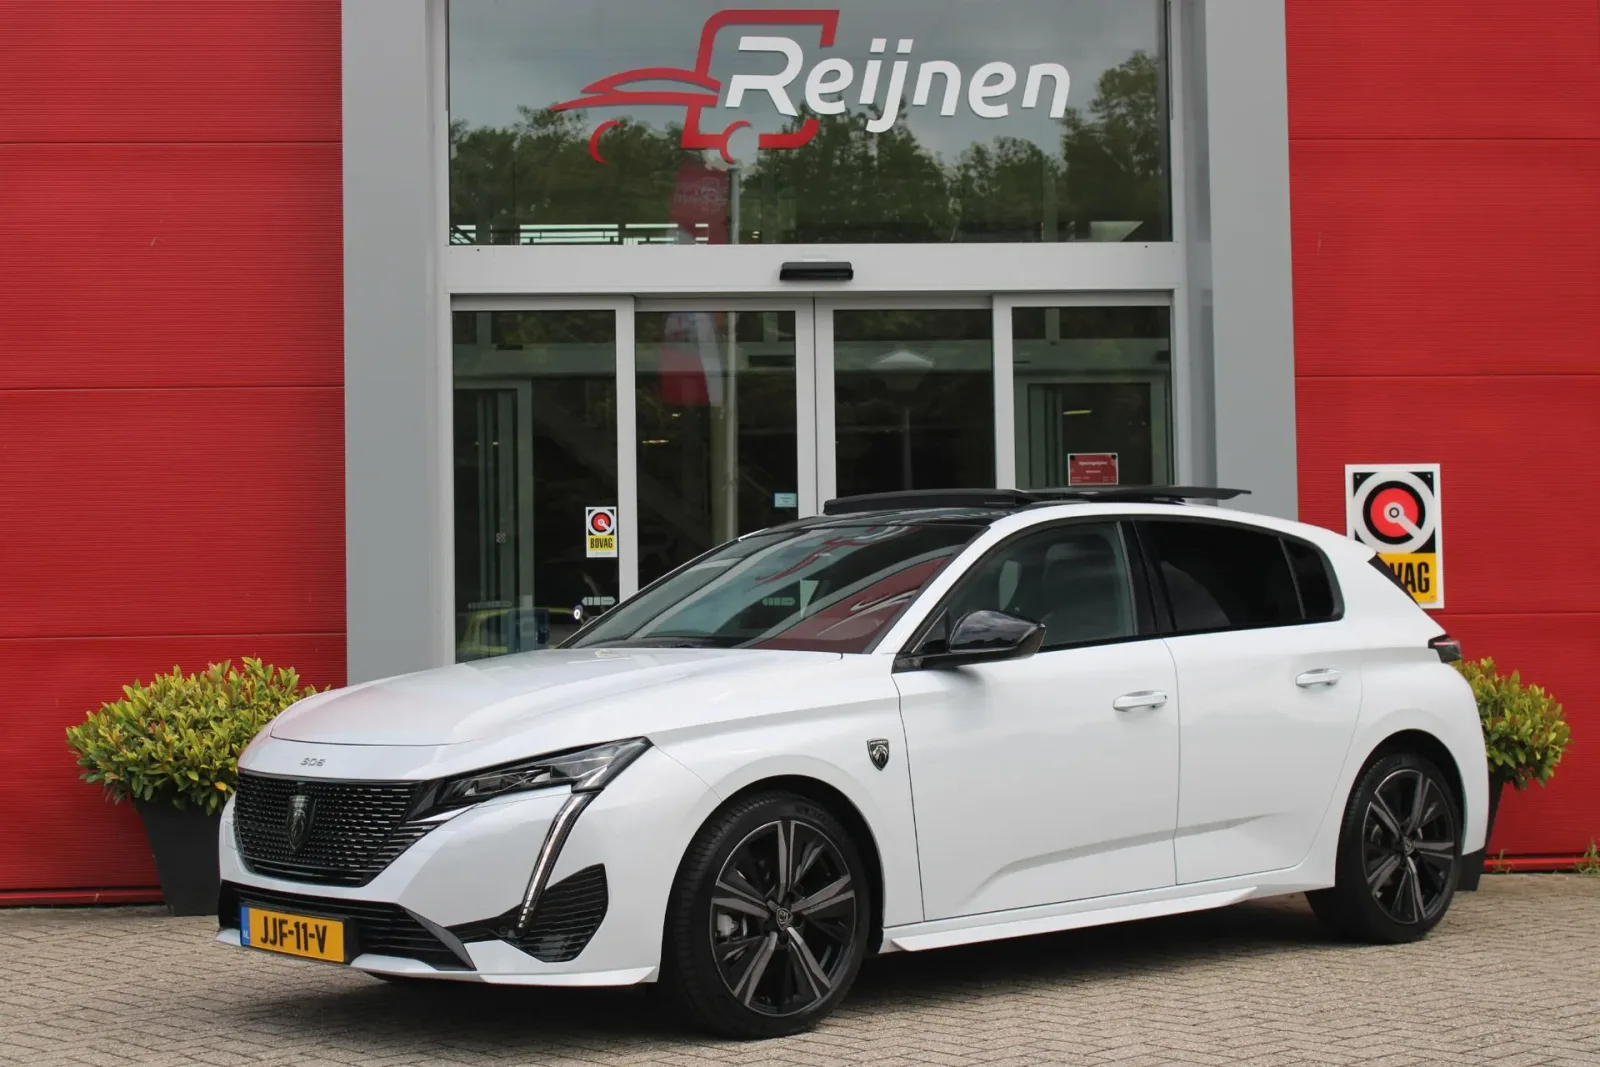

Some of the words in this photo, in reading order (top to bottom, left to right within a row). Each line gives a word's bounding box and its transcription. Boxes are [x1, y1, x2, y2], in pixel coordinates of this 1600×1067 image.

[725, 36, 1071, 133] Reijnen
[590, 538, 613, 549] BOVAG
[1390, 562, 1430, 593] VAG
[260, 916, 328, 954] JJF-11-V
